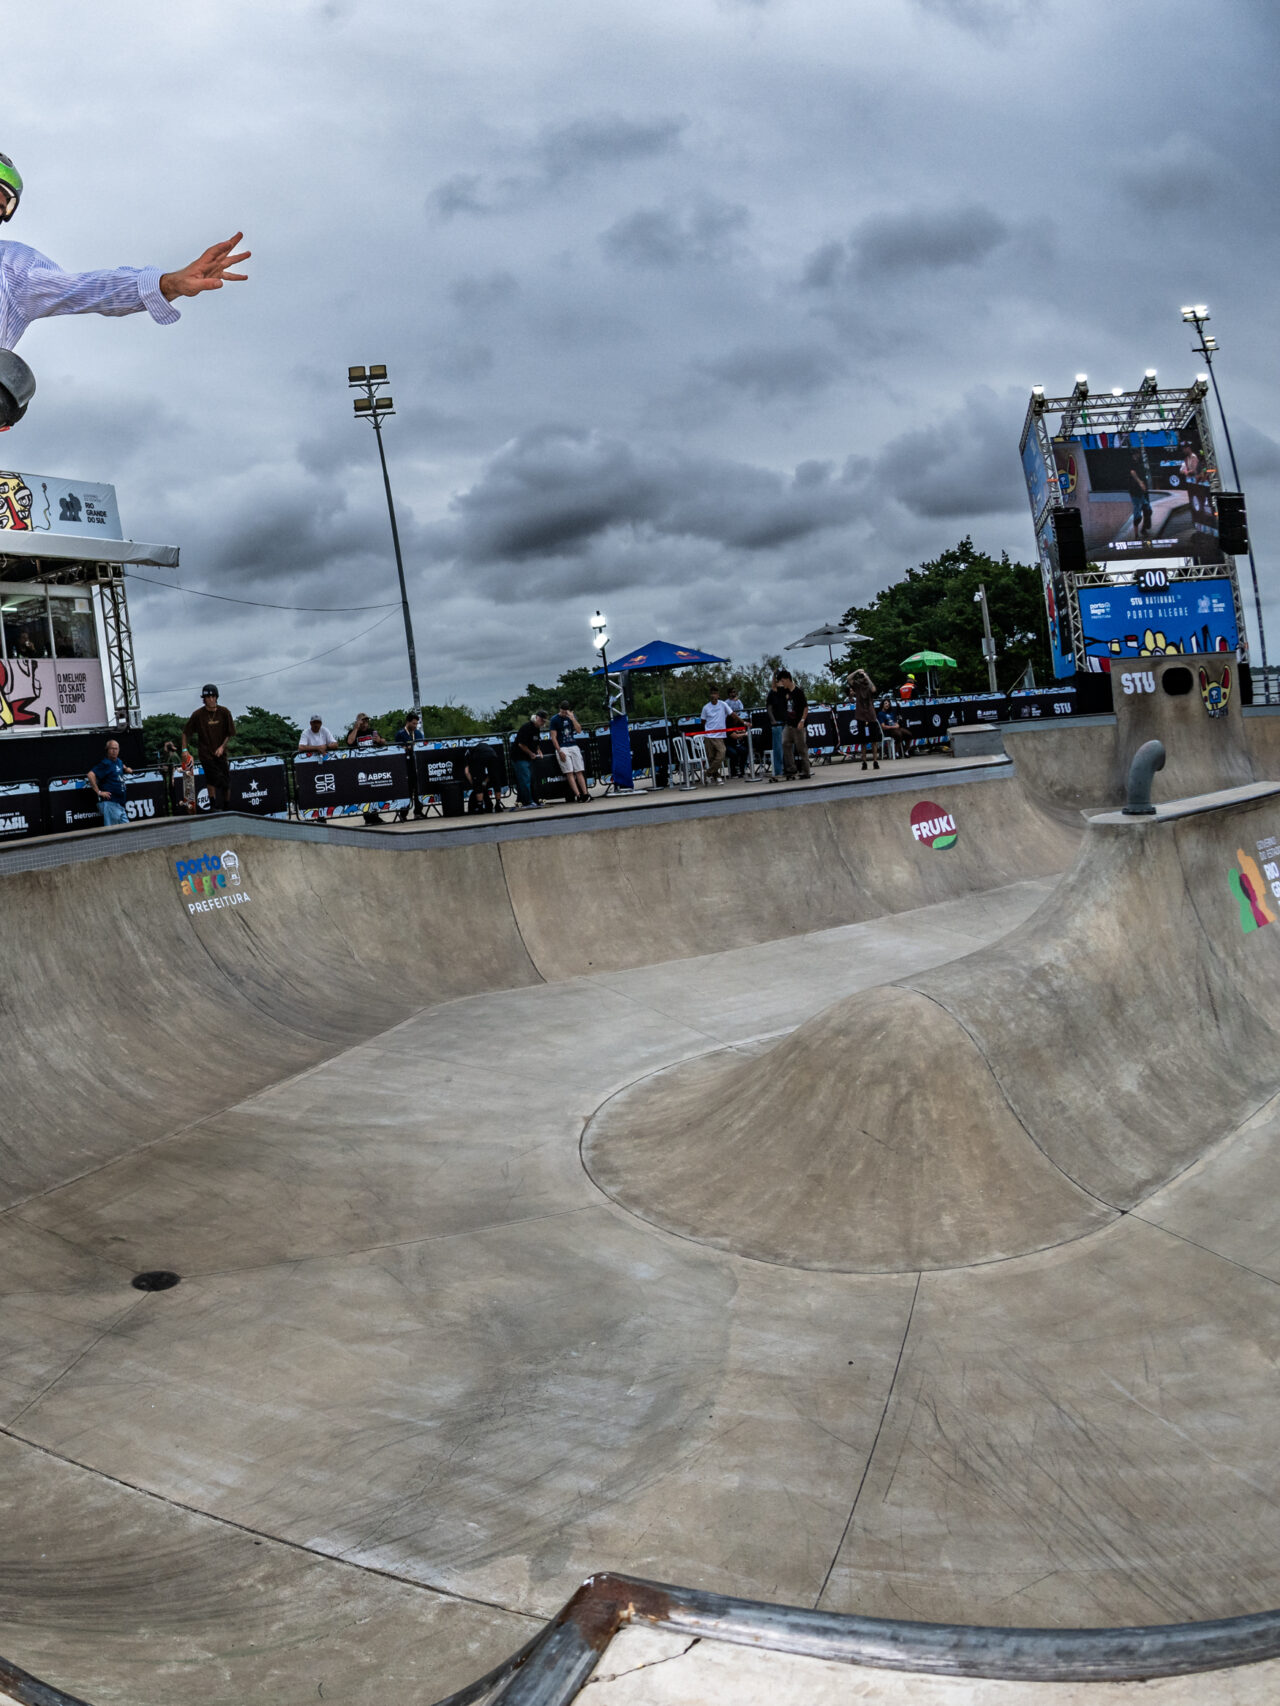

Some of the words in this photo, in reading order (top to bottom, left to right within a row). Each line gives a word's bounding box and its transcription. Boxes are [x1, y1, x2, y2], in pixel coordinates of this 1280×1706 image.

[62, 673, 87, 683] MELHOR
[1121, 671, 1156, 695] STU
[58, 685, 67, 693] DO
[67, 684, 87, 693] SKATE
[65, 694, 86, 703] TEMPO
[61, 704, 77, 714] TODO
[1053, 702, 1072, 714] STU
[807, 723, 826, 737] STU
[428, 762, 446, 771] porto
[241, 788, 268, 799] Heineken
[125, 798, 156, 819] STU
[911, 814, 956, 841] FRUKI
[176, 853, 221, 882] porto
[181, 873, 227, 896] alegre
[188, 891, 251, 915] PREFEITURA
